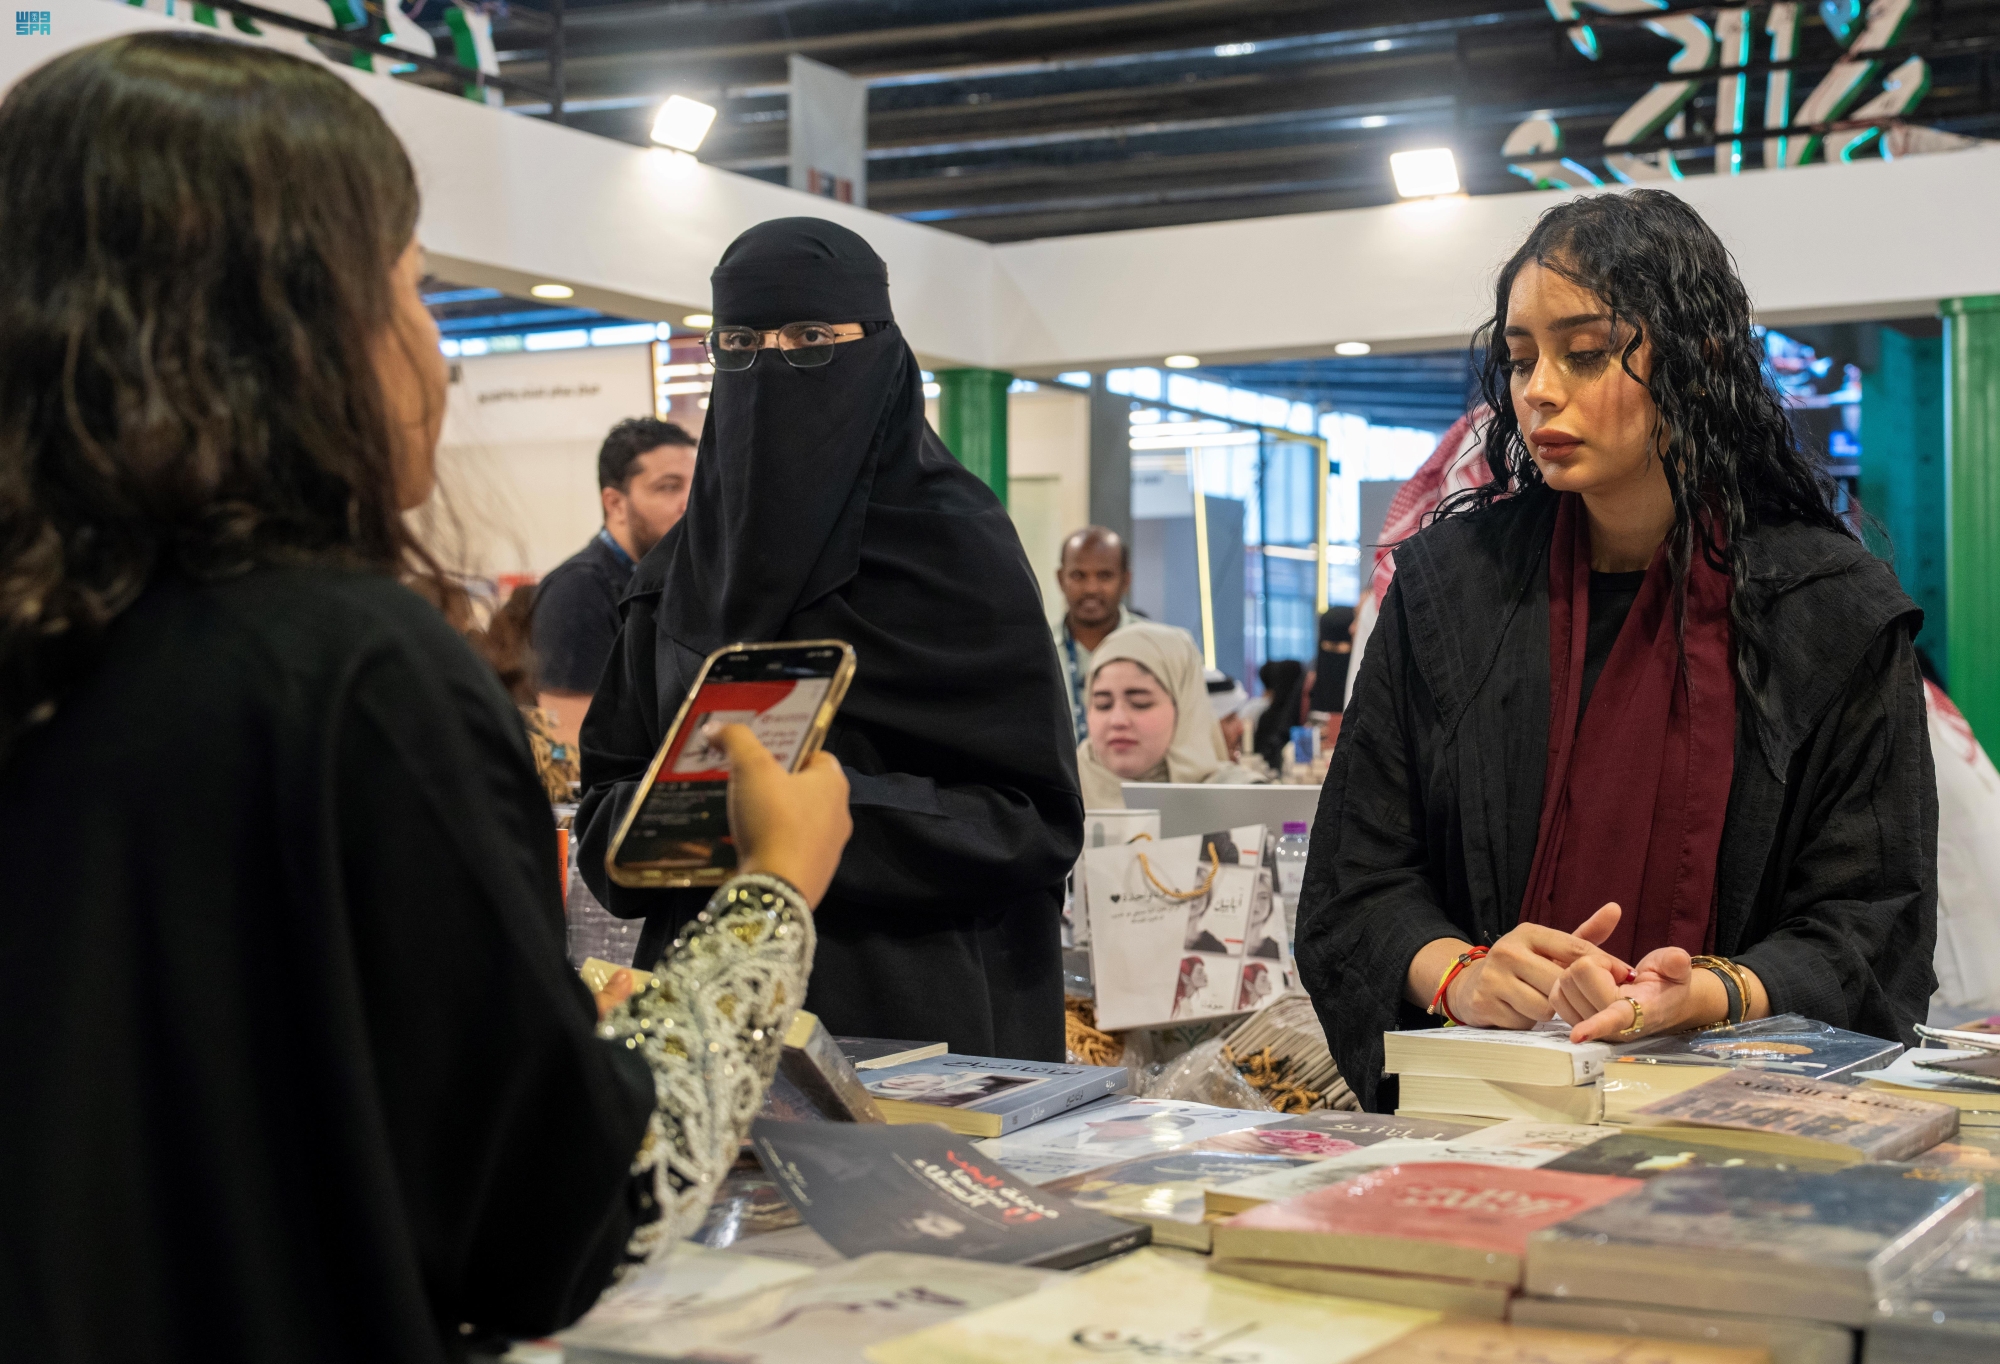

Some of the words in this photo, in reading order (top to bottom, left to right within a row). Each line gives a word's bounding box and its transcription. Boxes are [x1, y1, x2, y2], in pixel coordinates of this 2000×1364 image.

[912, 1157, 989, 1208] العقلاء
[946, 1150, 1005, 1189] الحب
[951, 1168, 1011, 1209] يسكنها
[999, 1186, 1060, 1219] مدينة
